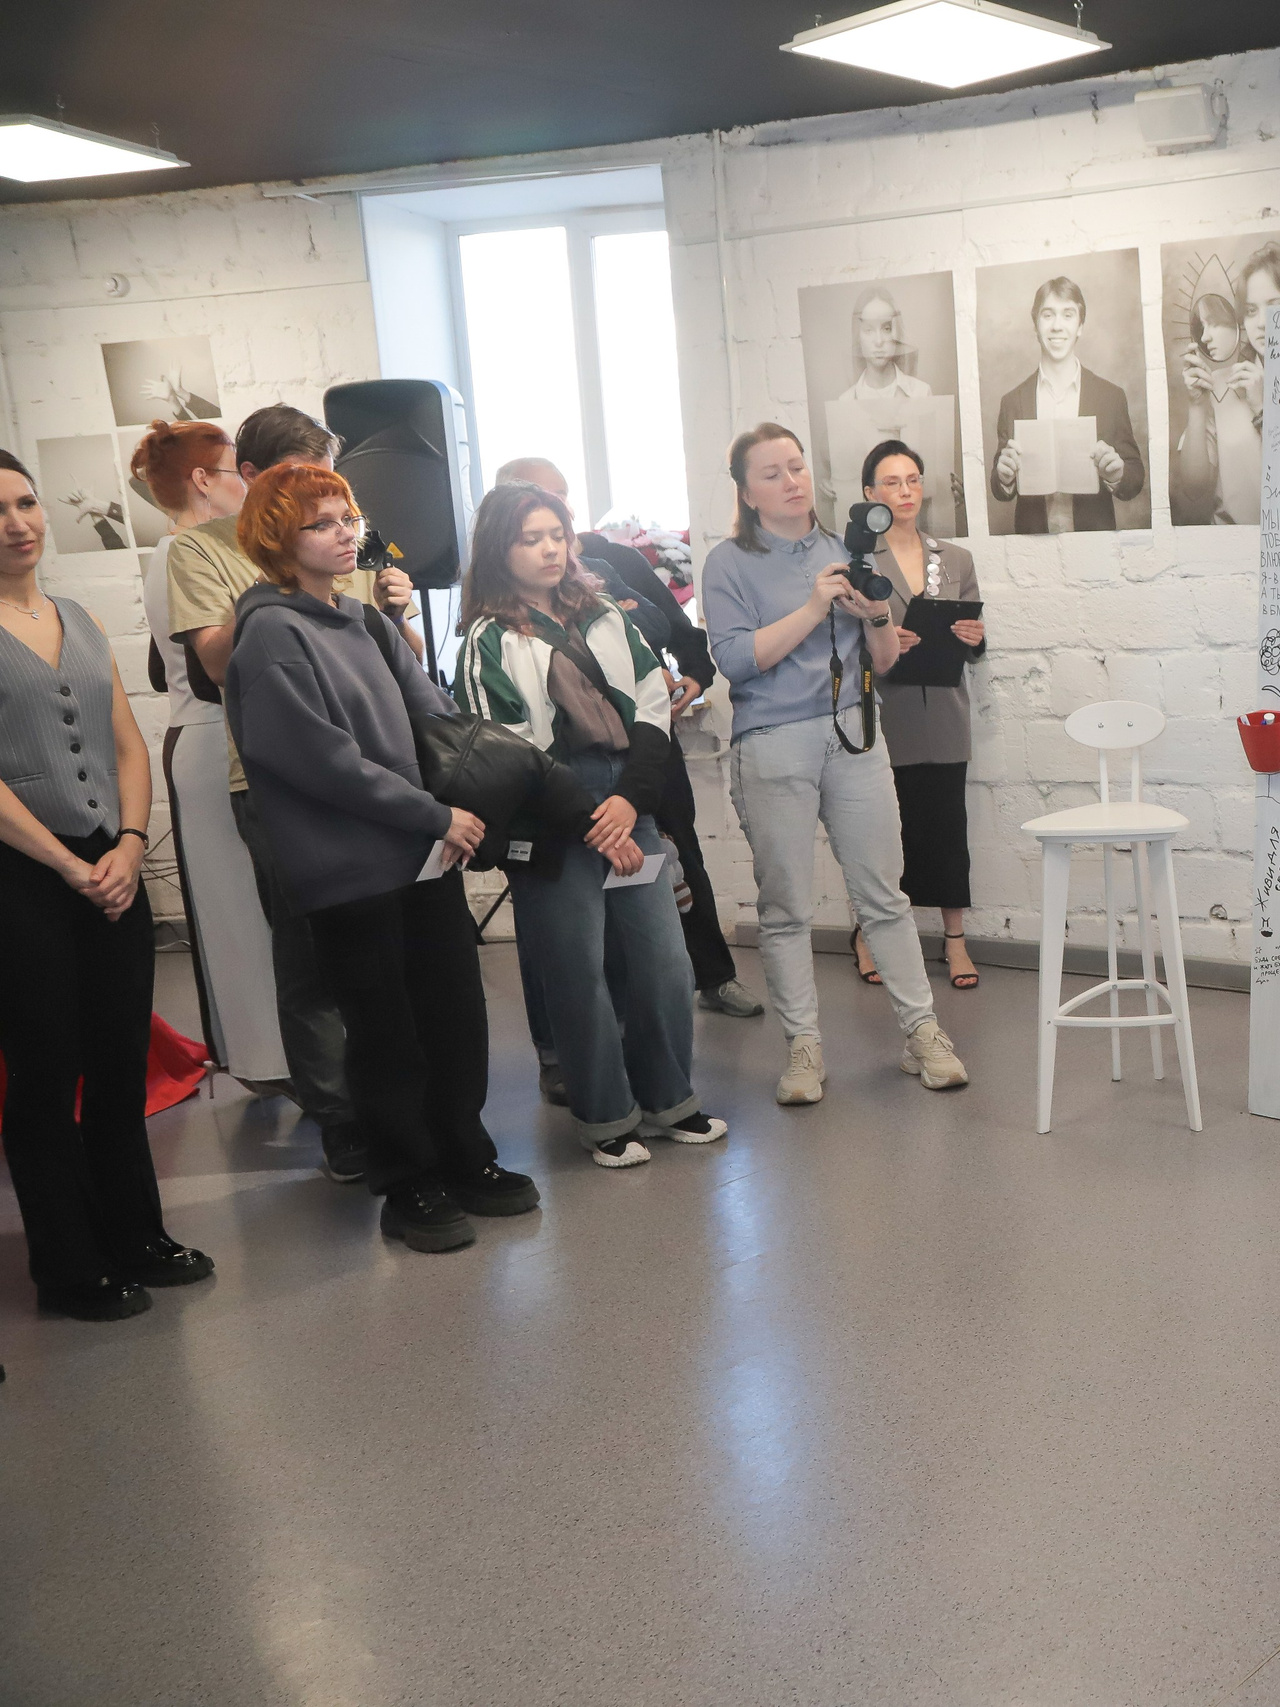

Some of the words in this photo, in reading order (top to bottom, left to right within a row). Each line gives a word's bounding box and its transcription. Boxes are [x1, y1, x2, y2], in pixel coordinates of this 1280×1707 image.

[1262, 509, 1280, 530] МЫ
[1261, 588, 1266, 599] А
[1263, 605, 1268, 614] В
